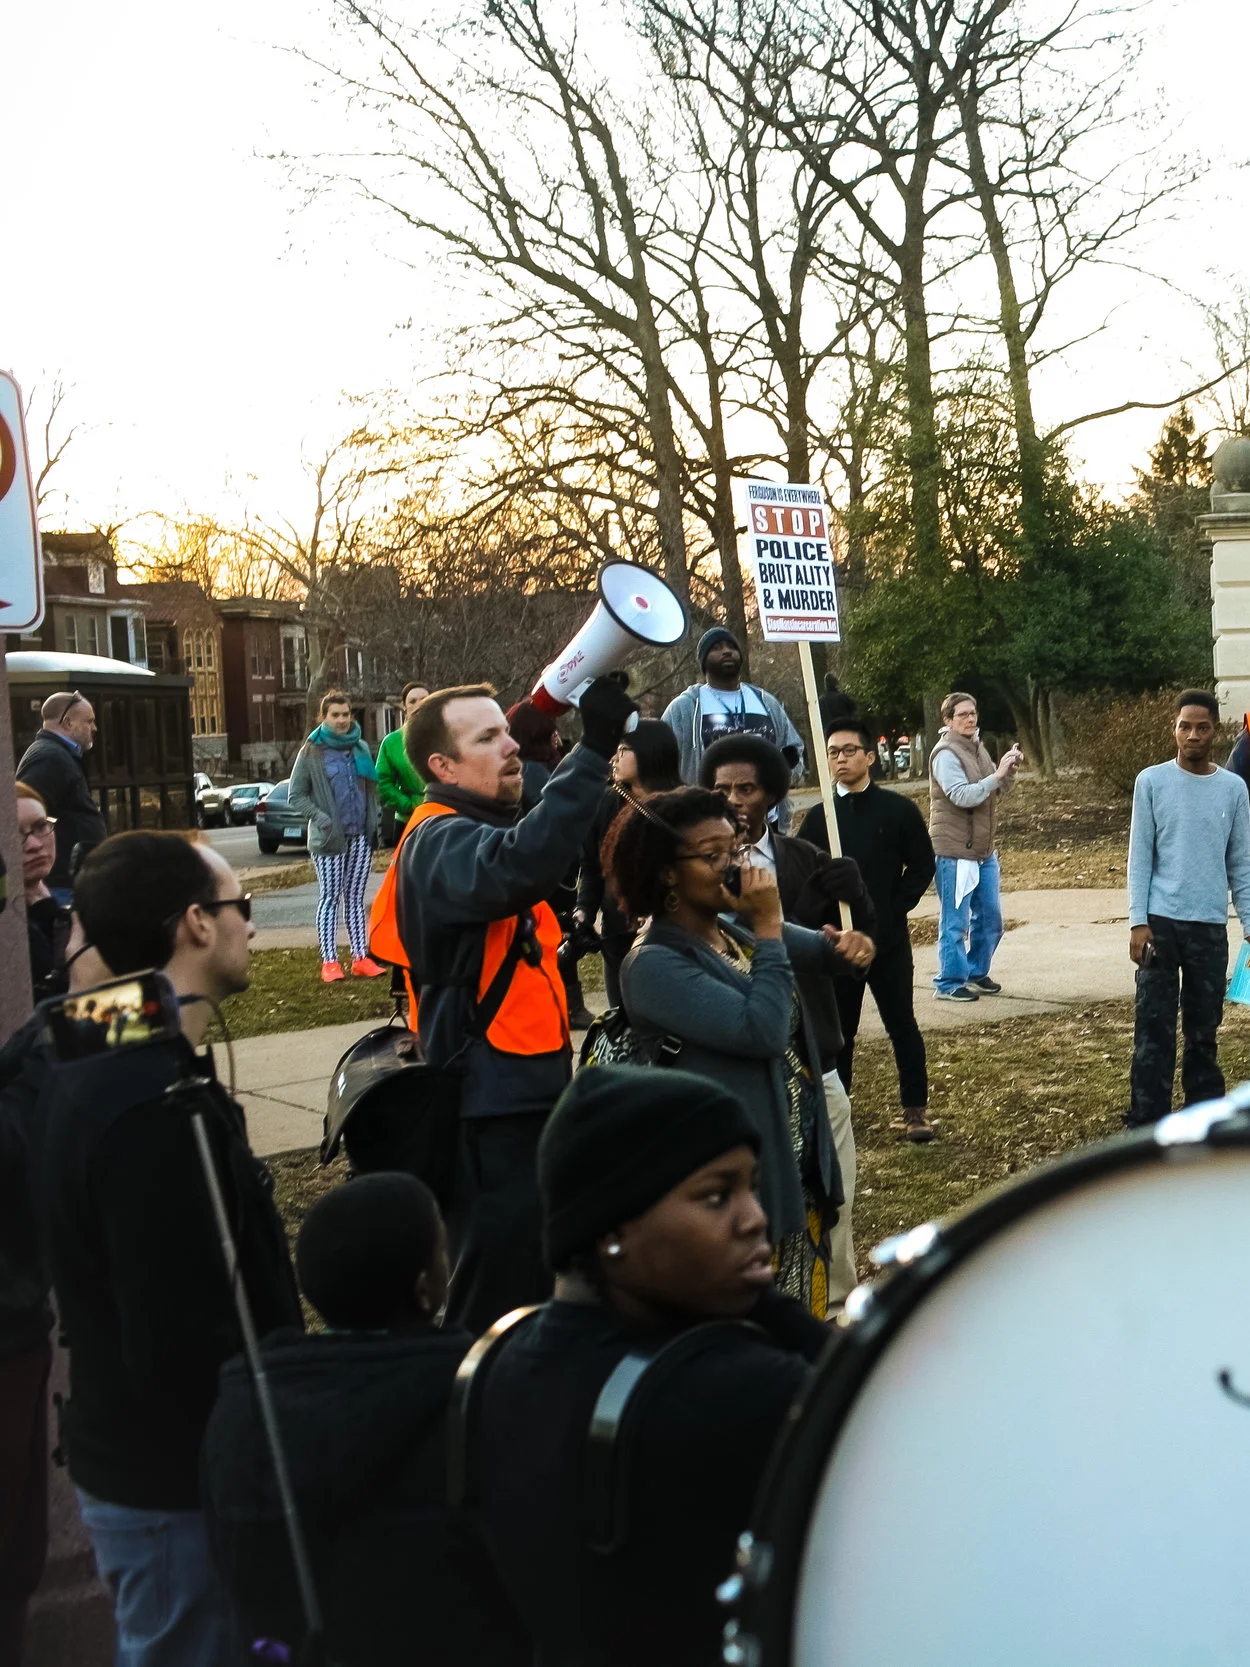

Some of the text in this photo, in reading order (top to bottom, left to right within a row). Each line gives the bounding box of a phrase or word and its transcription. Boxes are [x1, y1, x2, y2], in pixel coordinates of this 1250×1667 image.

[748, 485, 821, 504] FERGUSON IS EVERYWHERE
[754, 506, 821, 536] STOP
[756, 539, 829, 562] POLICE
[759, 562, 831, 586] BRUTALITY
[763, 588, 836, 611] & MURDER
